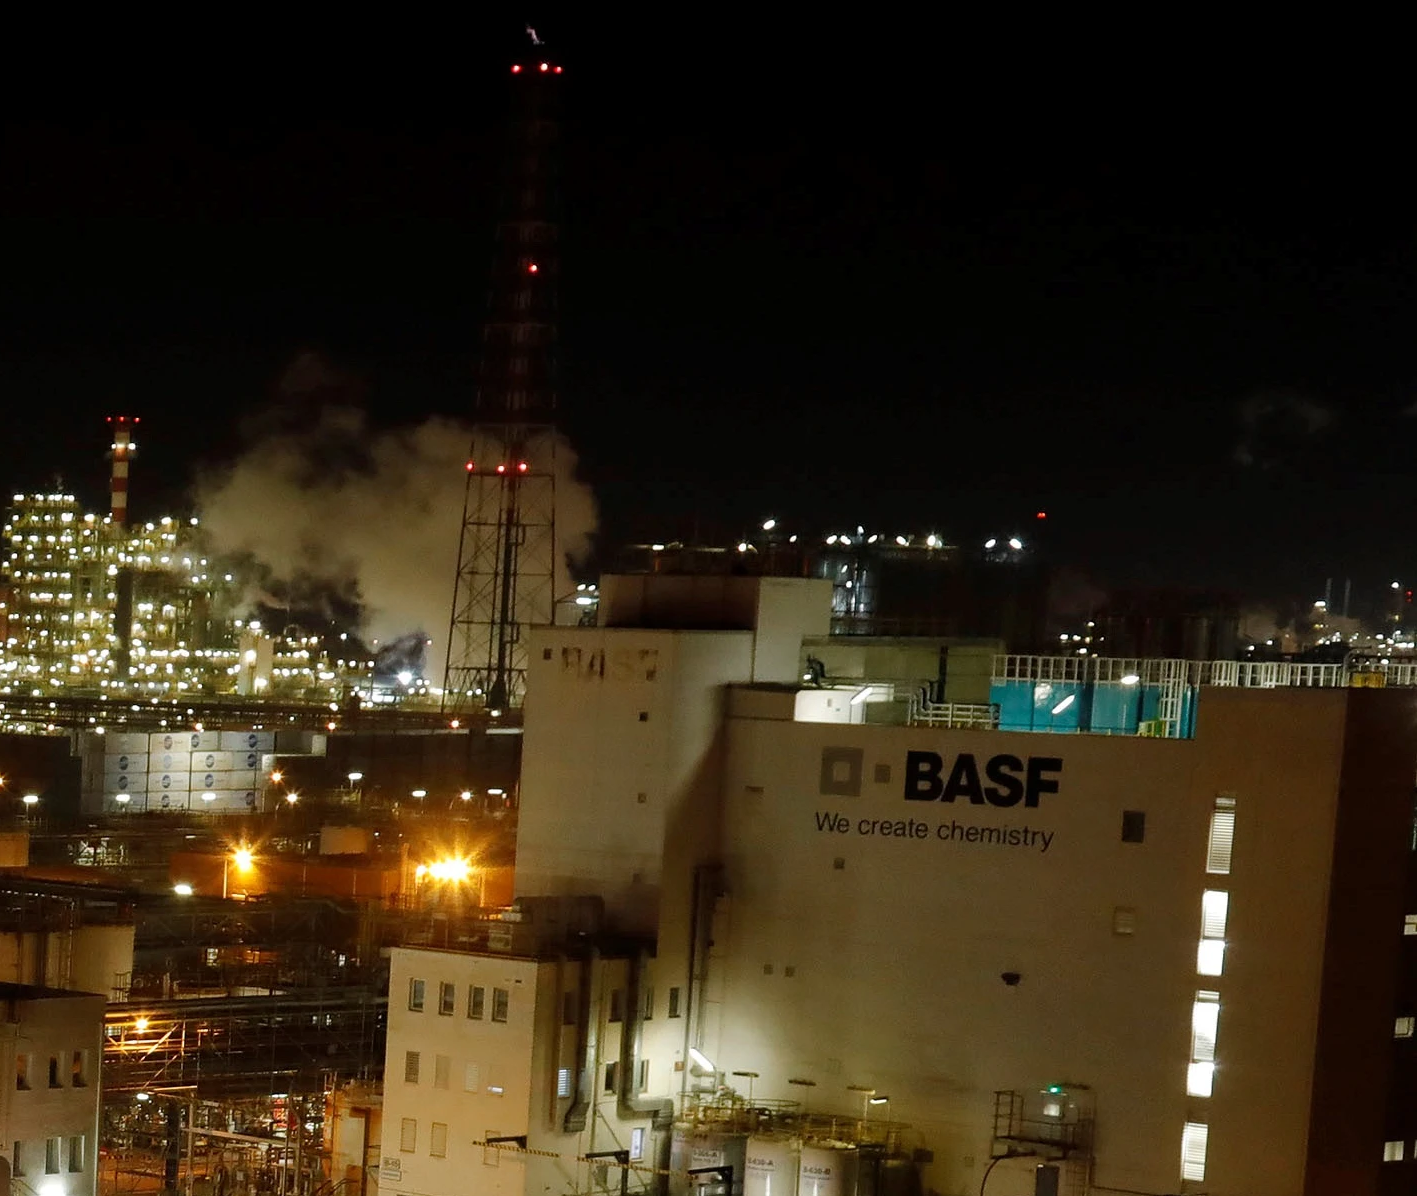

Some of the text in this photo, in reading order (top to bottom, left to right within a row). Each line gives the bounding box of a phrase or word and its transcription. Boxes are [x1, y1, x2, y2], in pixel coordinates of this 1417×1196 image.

[904, 751, 1063, 809] BASF
[816, 812, 1055, 852] We create chemistry
